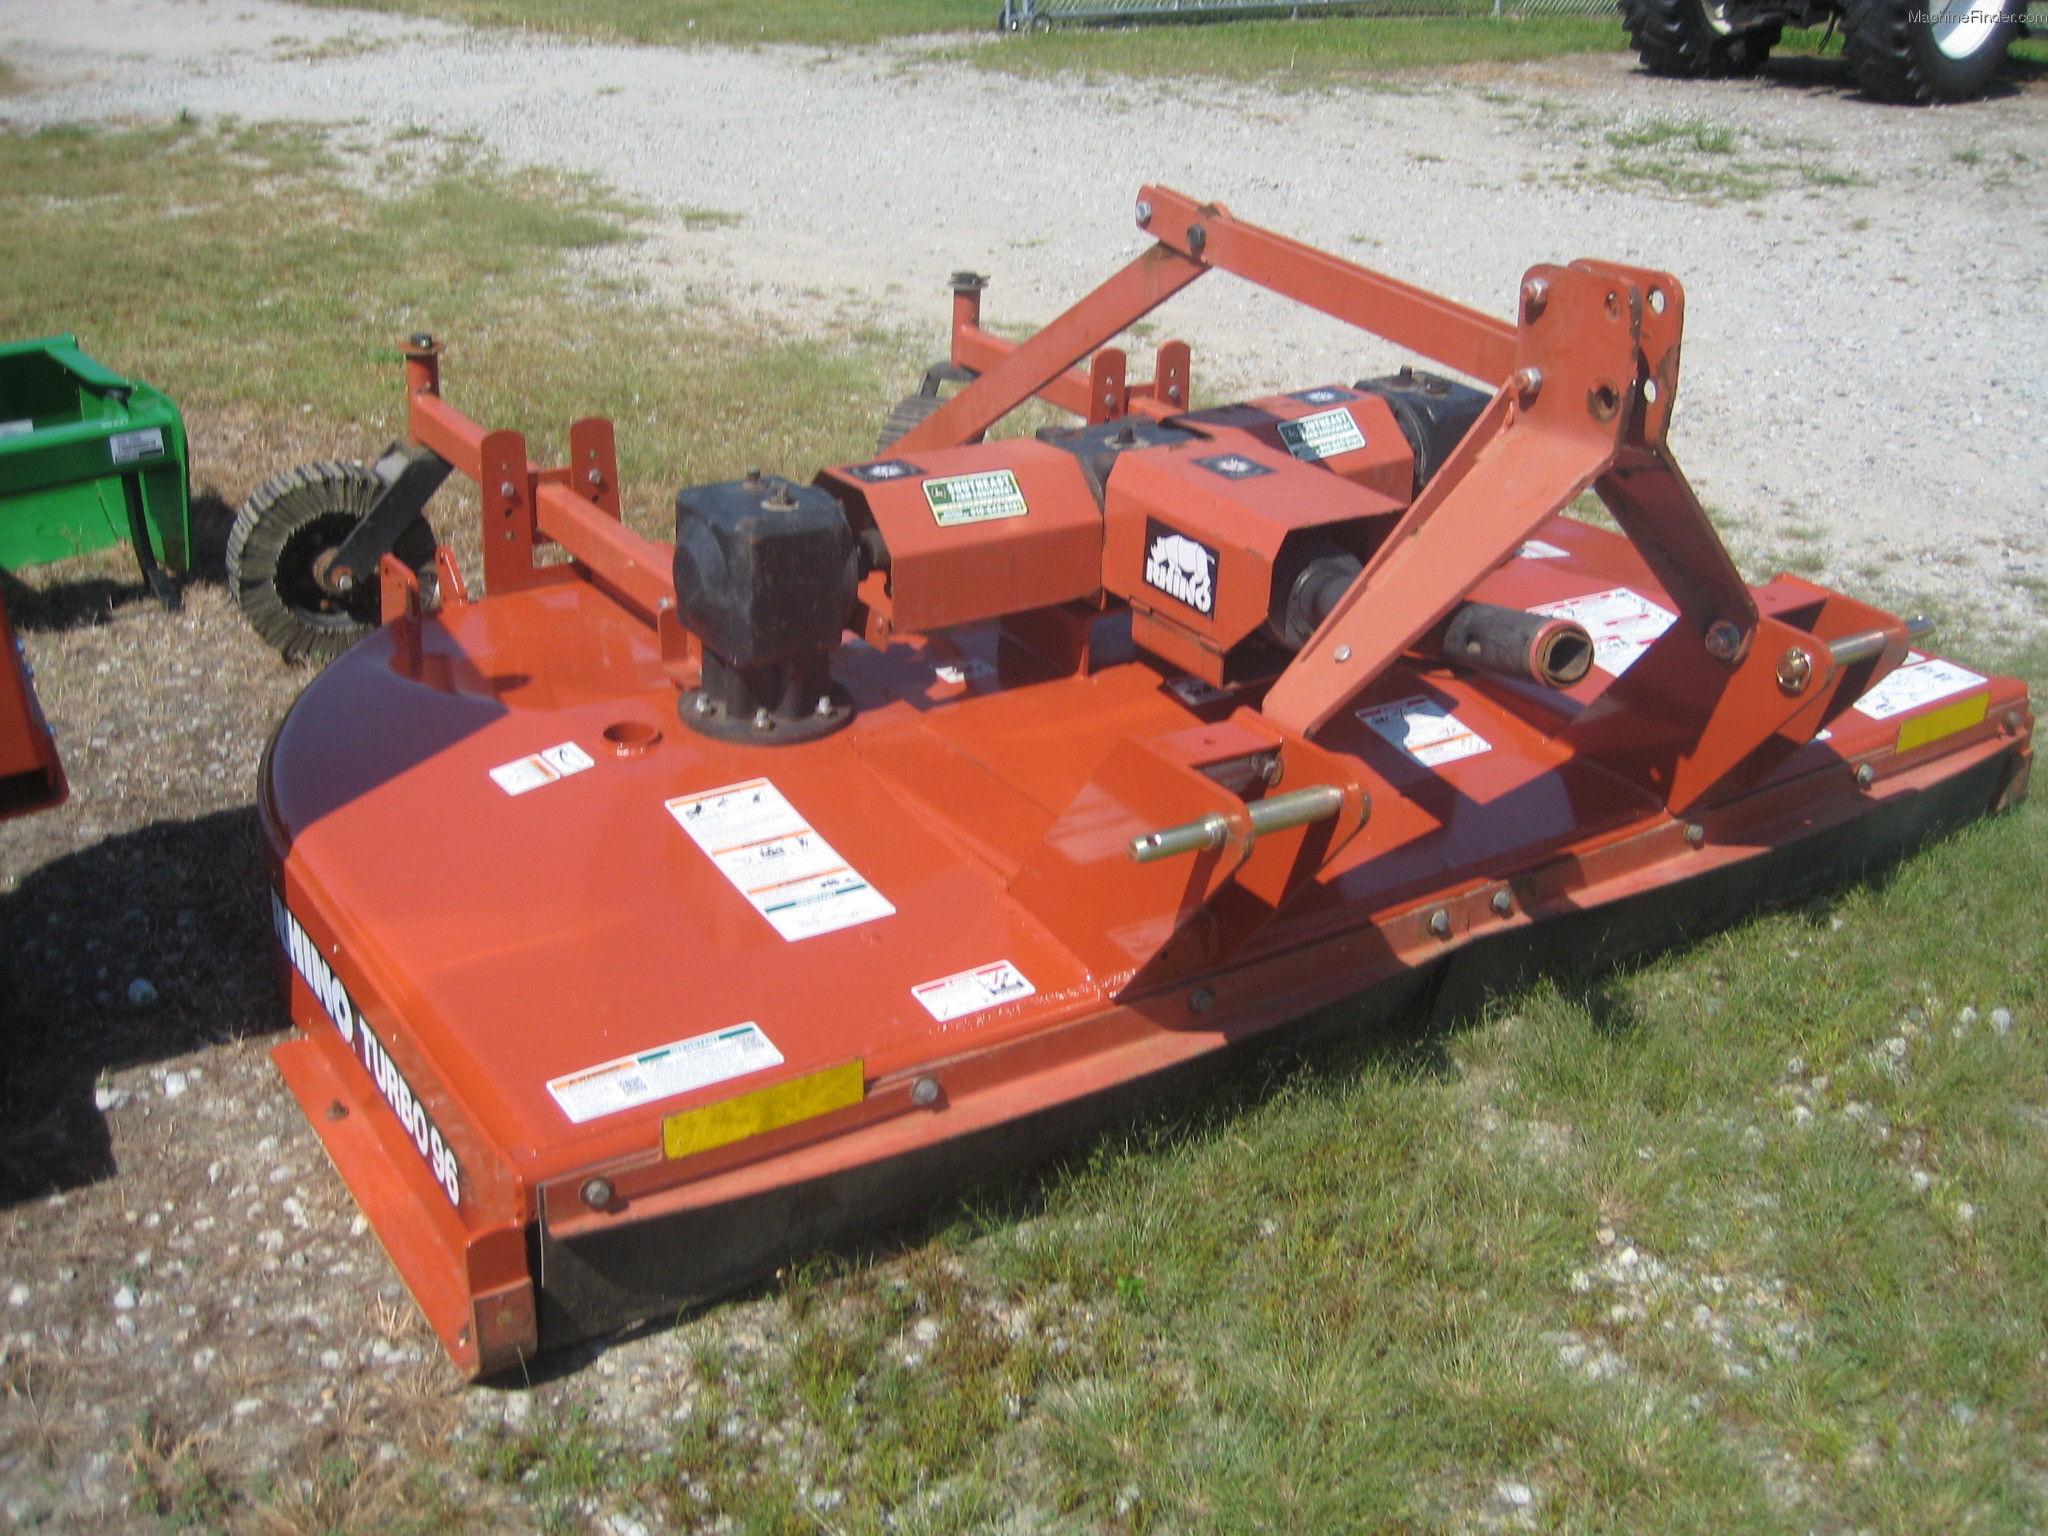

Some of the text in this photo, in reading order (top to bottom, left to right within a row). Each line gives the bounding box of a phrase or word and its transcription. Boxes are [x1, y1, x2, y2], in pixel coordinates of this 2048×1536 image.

[1145, 556, 1211, 613] RHINO
[359, 1014, 429, 1157] TURBO
[430, 1125, 460, 1206] 96
